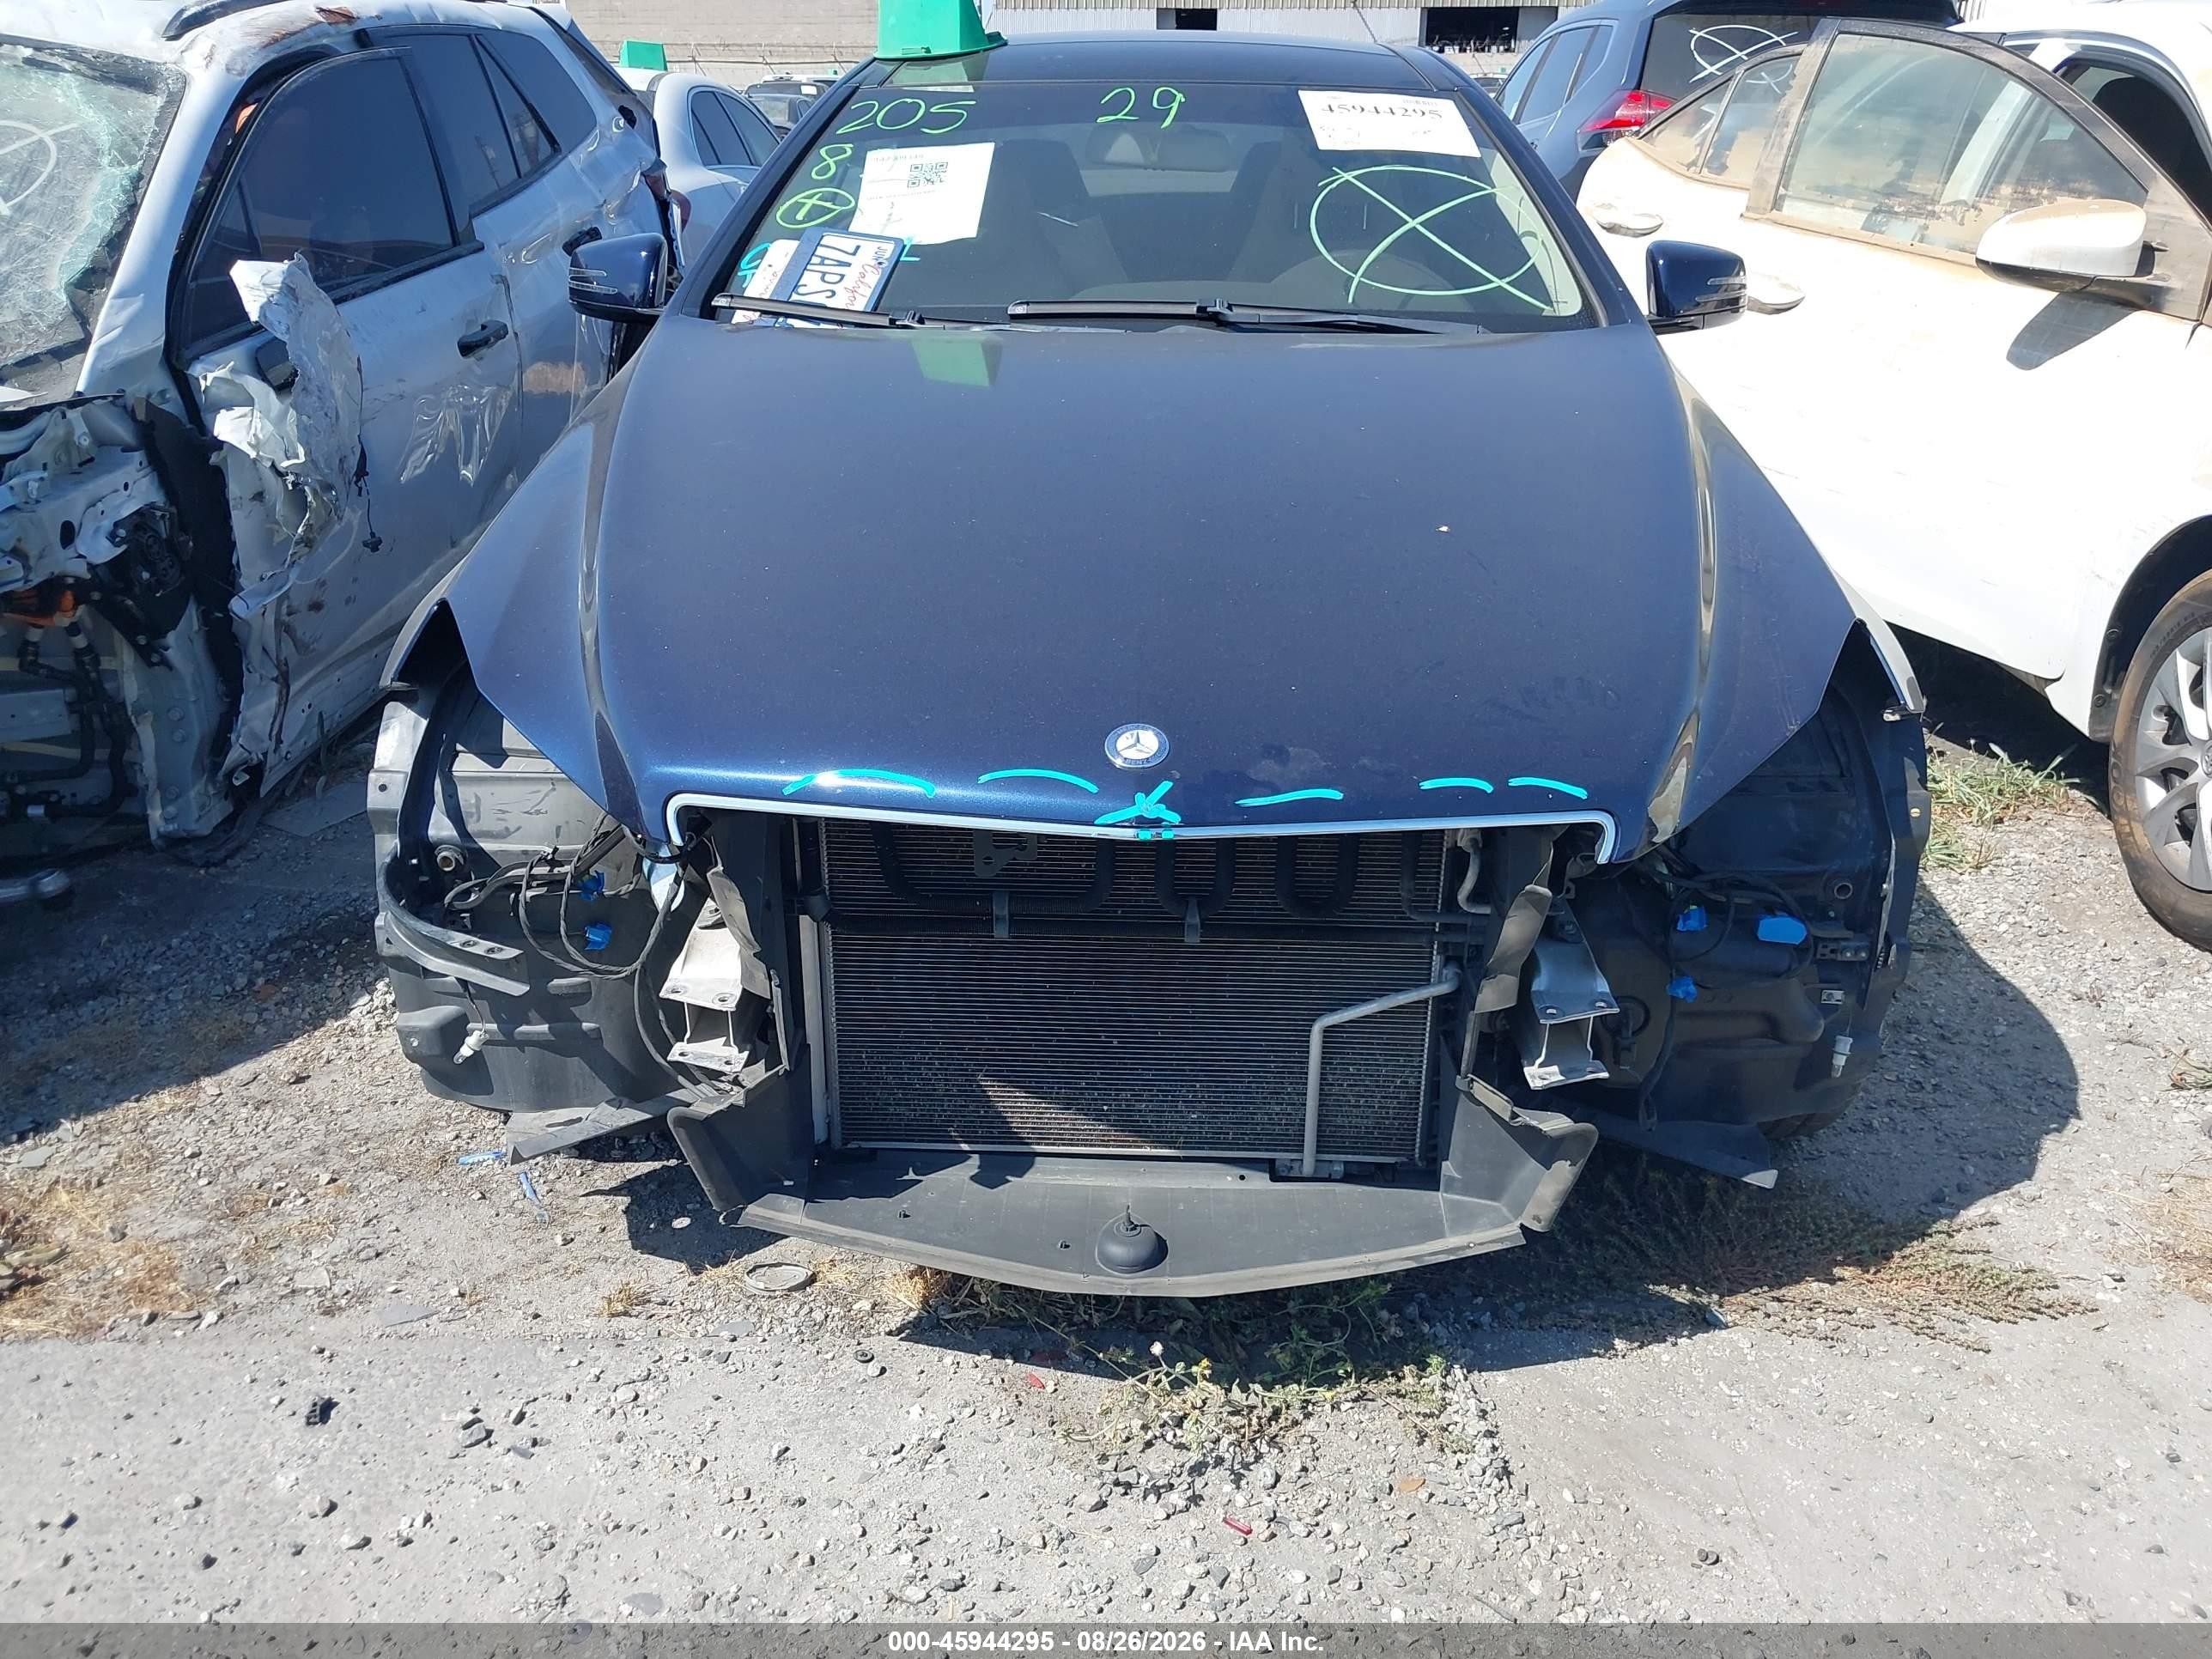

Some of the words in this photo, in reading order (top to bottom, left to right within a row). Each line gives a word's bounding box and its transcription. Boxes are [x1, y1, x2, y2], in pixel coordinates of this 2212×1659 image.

[836, 98, 976, 135] 205
[1321, 103, 1443, 120] 45944295
[811, 143, 854, 179] 8
